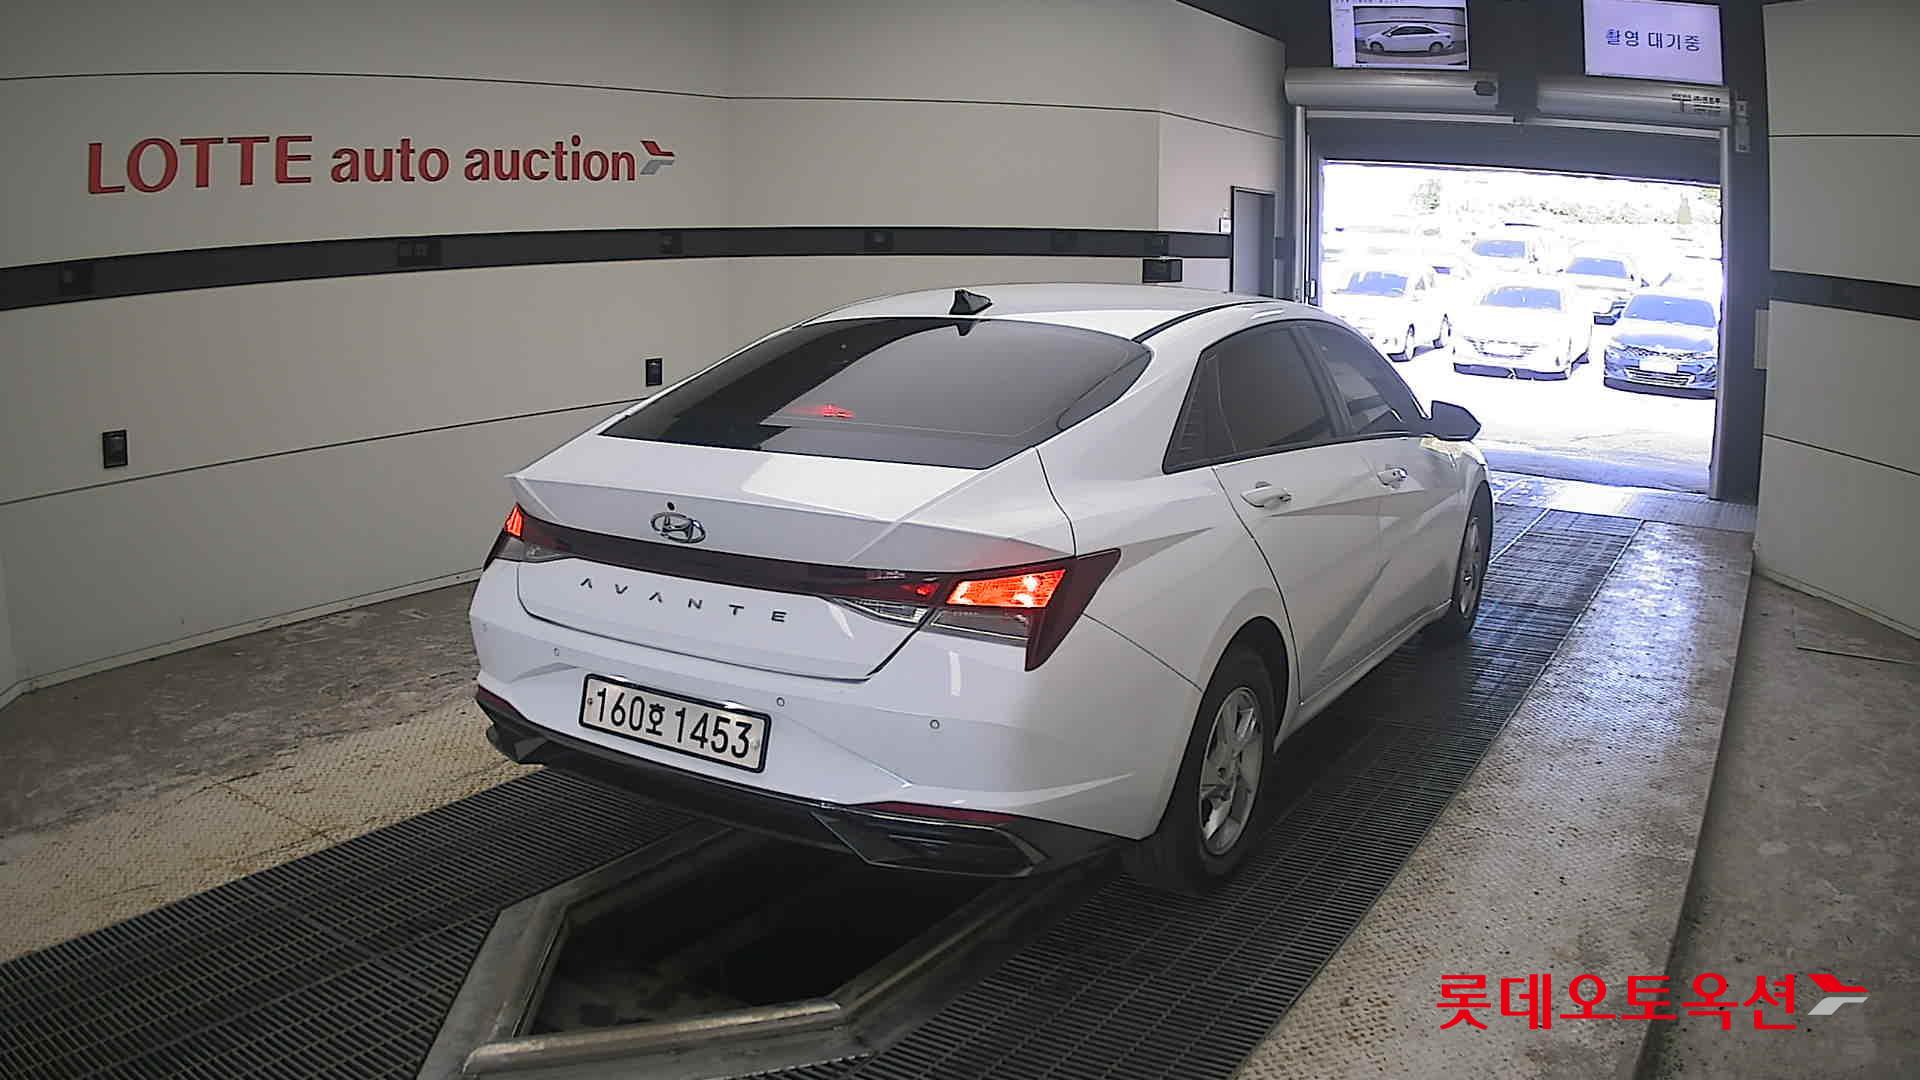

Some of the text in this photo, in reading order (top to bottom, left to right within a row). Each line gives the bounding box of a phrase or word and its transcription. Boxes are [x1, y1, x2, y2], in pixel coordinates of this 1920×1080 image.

[1606, 29, 1701, 52] 촬영 대기중
[88, 135, 637, 194] LOTTE auto auction
[580, 577, 788, 623] AVANTE
